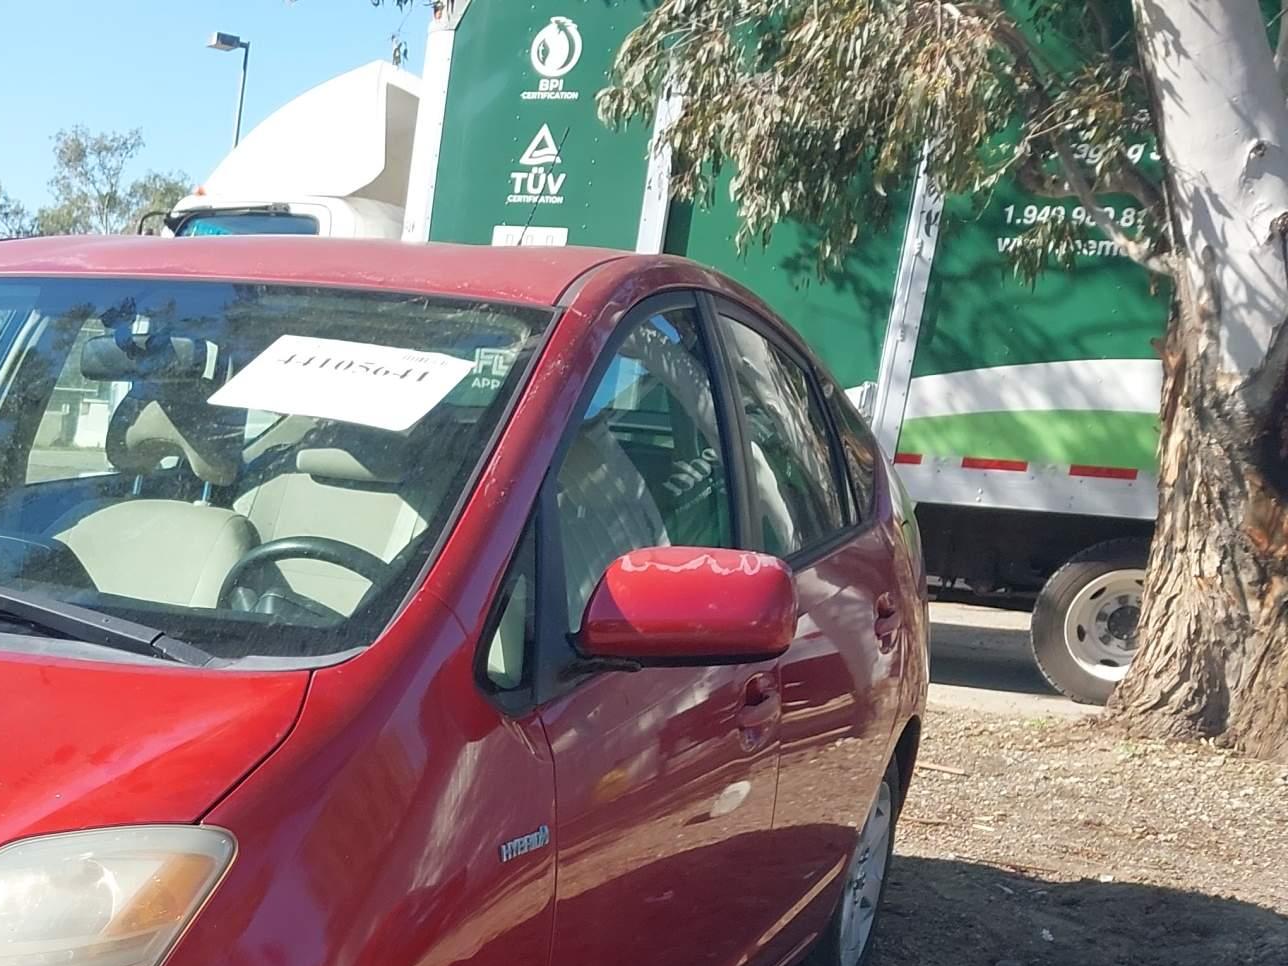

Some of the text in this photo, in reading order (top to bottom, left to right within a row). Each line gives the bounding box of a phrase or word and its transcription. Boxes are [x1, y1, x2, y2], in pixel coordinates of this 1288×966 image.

[539, 79, 563, 91] BPI
[520, 91, 579, 100] CERTIFICATION
[511, 167, 566, 195] TÜV
[507, 195, 563, 204] CERTIFICATION
